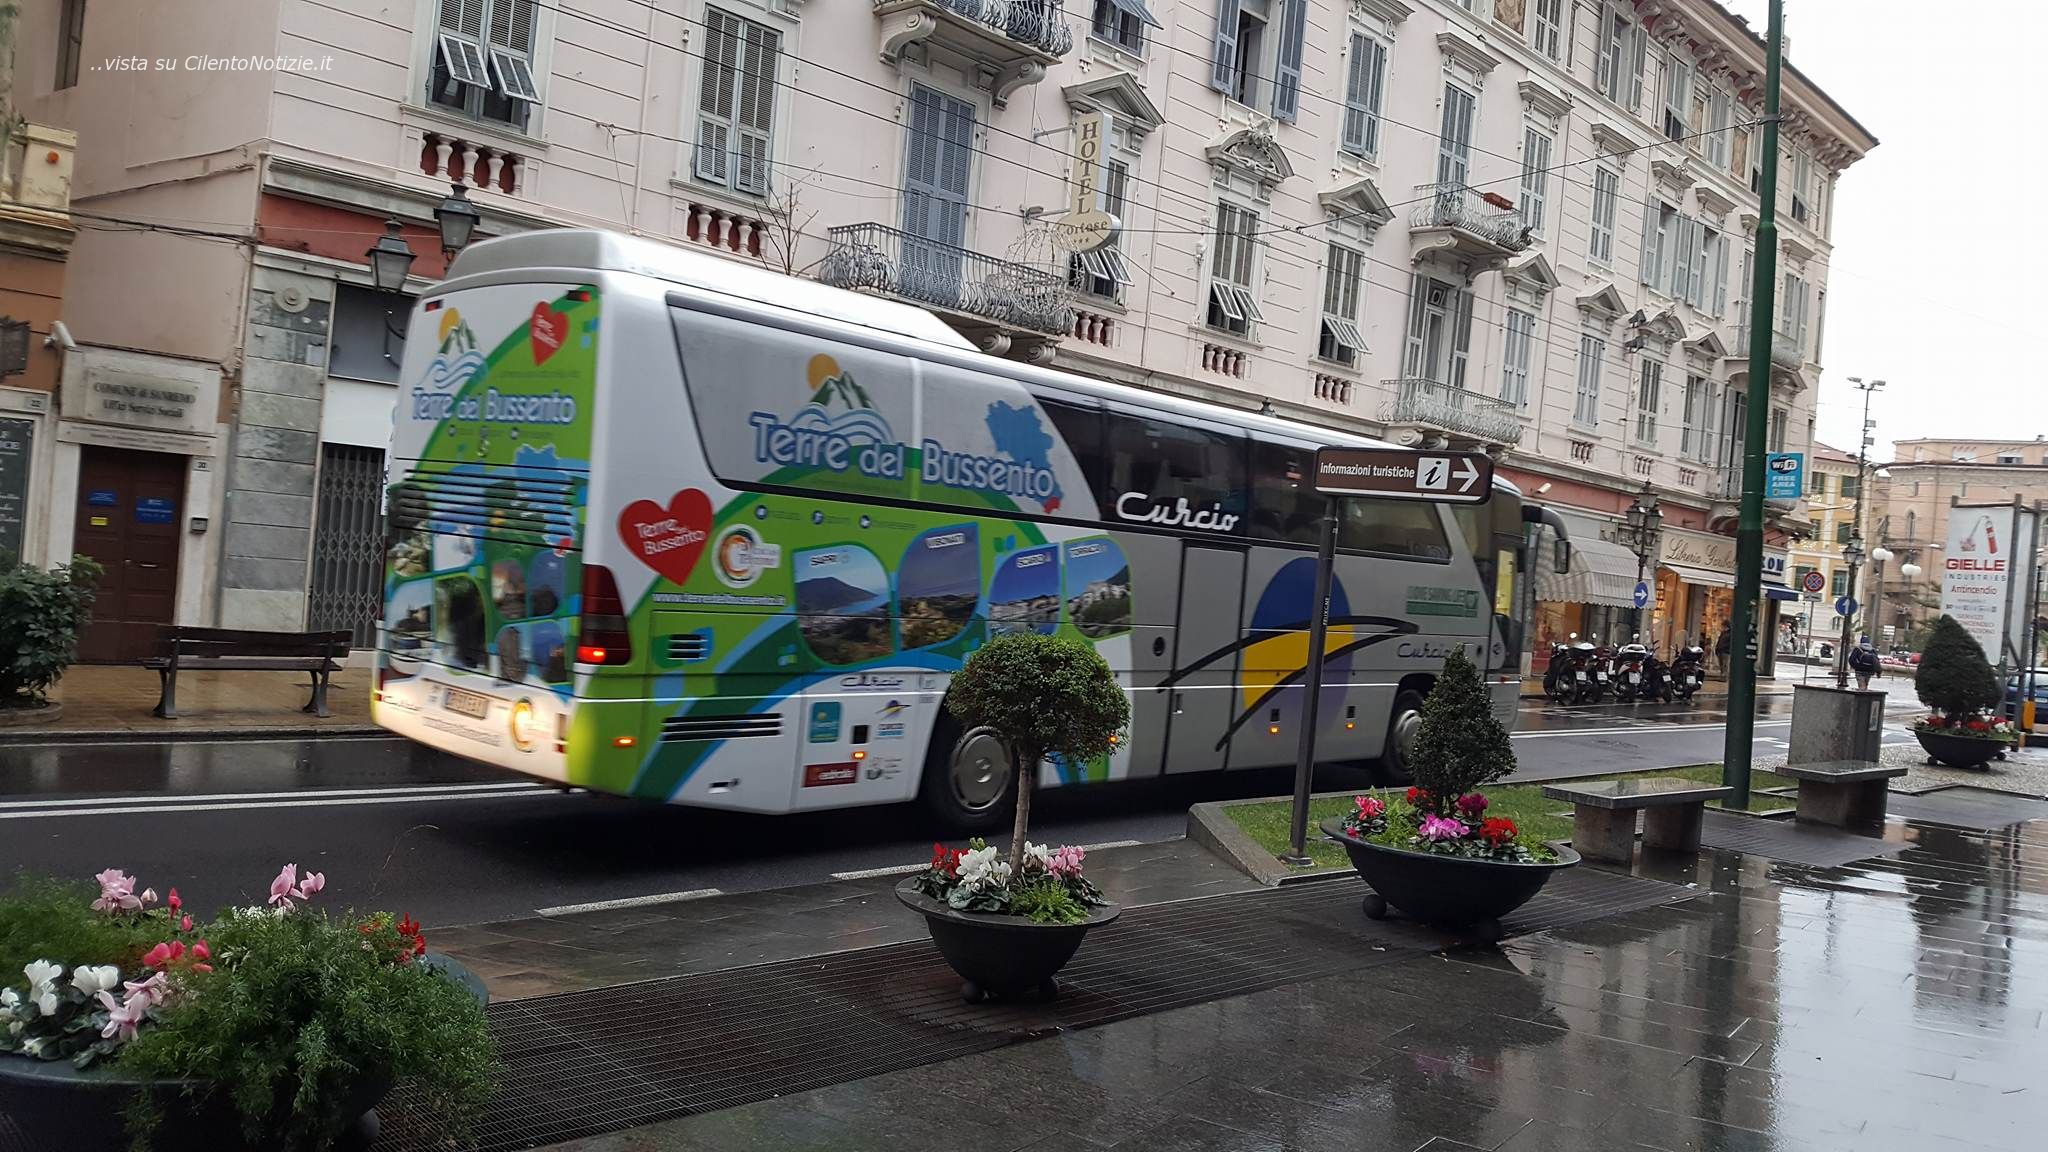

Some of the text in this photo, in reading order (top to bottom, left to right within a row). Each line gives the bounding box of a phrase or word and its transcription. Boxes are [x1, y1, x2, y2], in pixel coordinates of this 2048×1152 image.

[1076, 121, 1098, 215] HOTEL
[412, 386, 453, 421] Terre
[484, 386, 577, 427] Bussento
[749, 410, 1055, 500] Terre del Bussento
[1373, 465, 1415, 479] turistiche
[1116, 491, 1240, 532] Curcio
[634, 518, 682, 540] Terre
[643, 530, 706, 556] Bussento
[1946, 558, 2006, 572] GIELLE
[1945, 573, 2007, 582] INDUSTRIES
[1951, 584, 1997, 595] Antincendio
